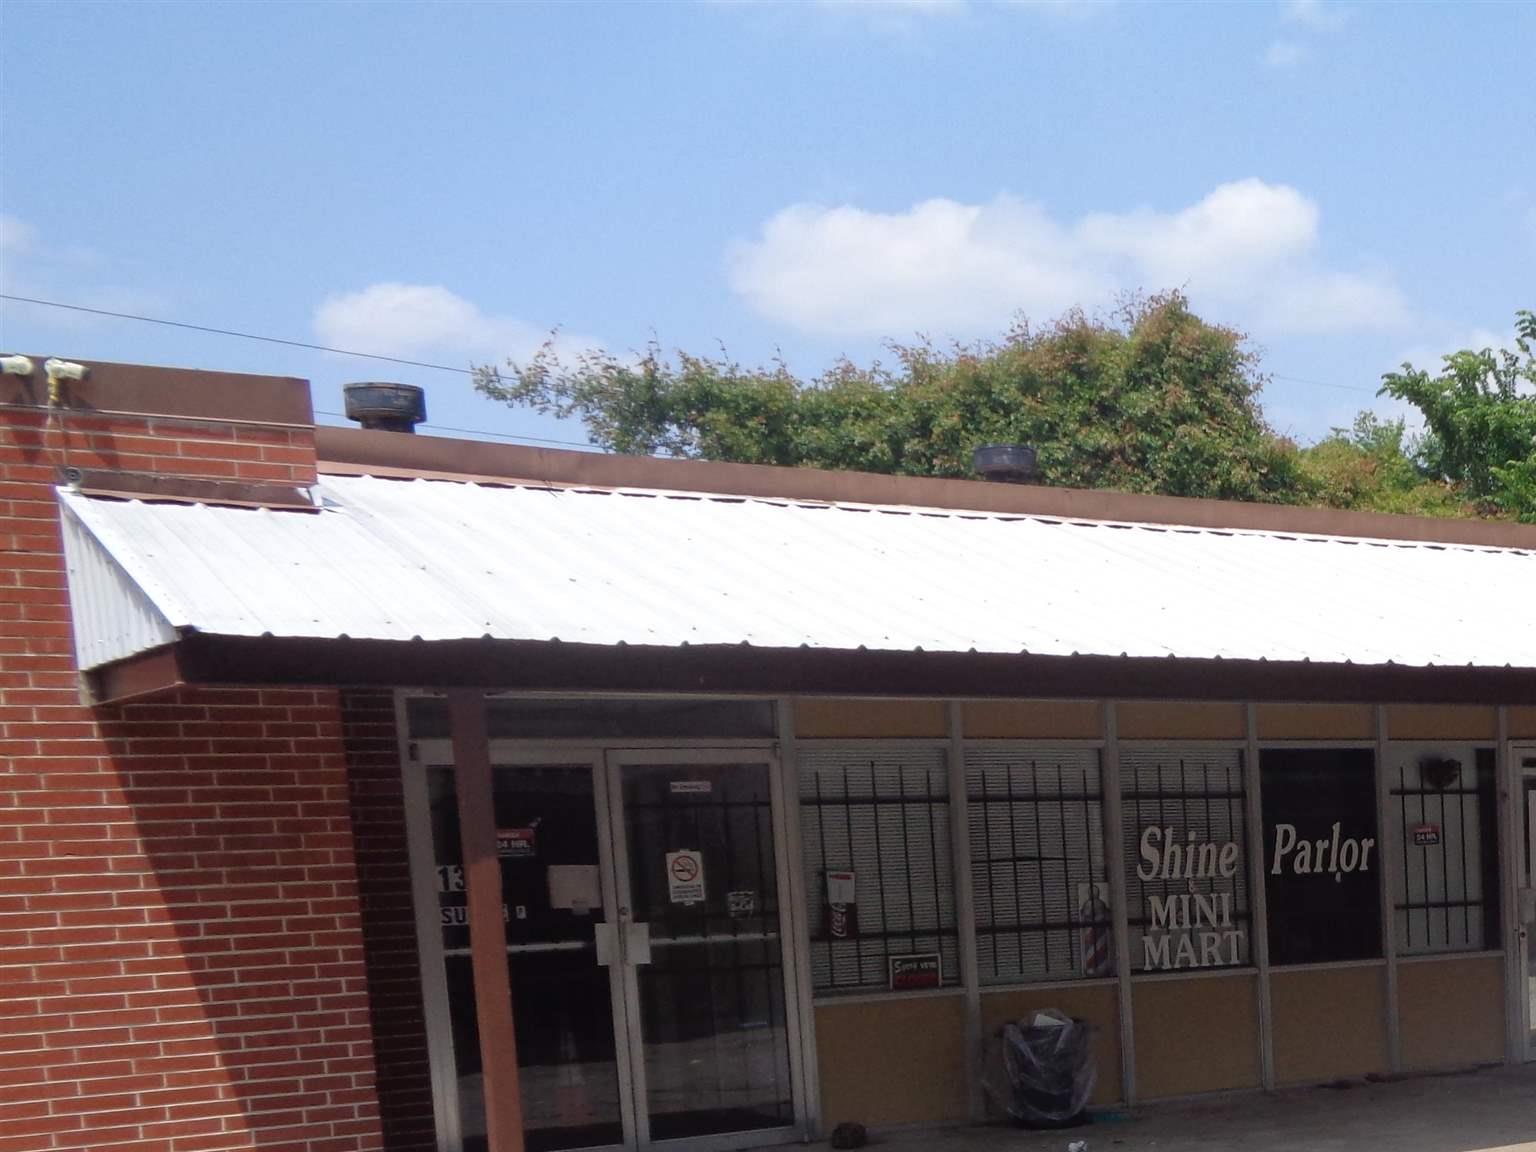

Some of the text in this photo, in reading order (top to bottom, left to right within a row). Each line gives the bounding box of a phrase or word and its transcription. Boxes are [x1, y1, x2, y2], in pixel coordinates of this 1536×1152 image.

[1136, 821, 1375, 882] Shine Parlor
[1148, 893, 1233, 930] MINI
[1143, 931, 1244, 971] MART
